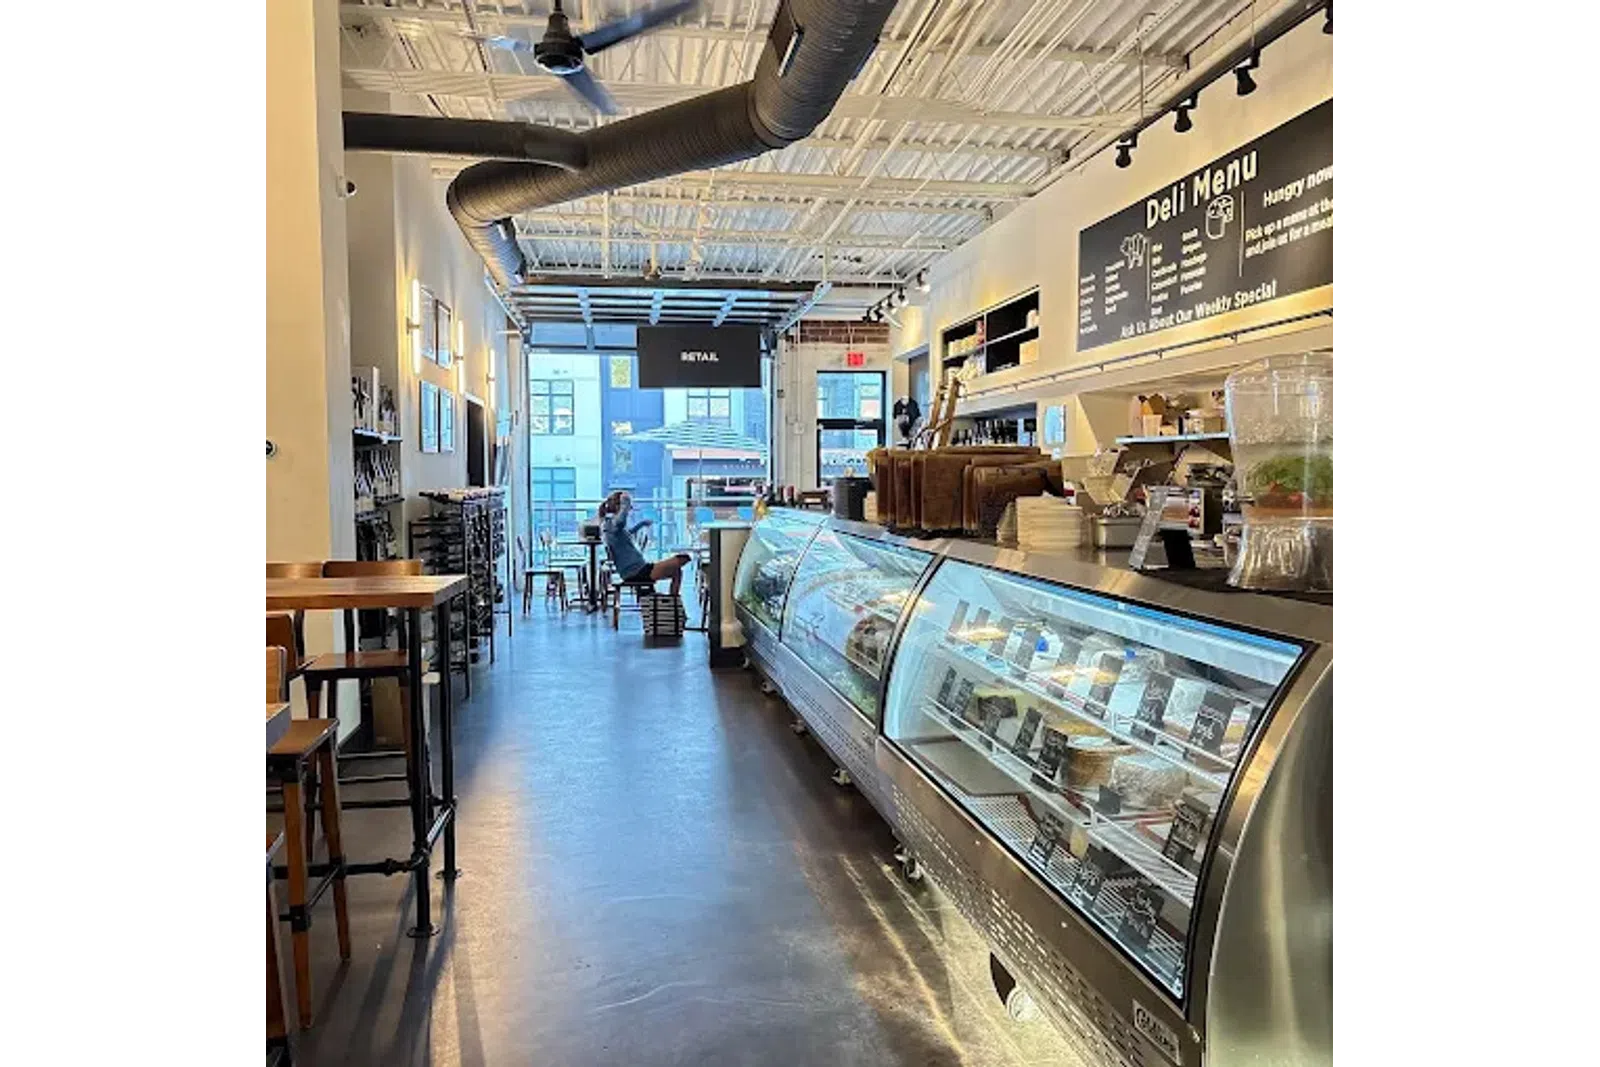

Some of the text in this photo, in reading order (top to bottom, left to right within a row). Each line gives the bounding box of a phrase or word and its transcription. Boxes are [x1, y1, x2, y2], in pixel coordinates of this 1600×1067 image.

[1146, 150, 1257, 229] Deli Menu
[1263, 177, 1305, 208] Hungry
[1245, 225, 1263, 242] Pick
[1120, 278, 1278, 338] Ask Us About Our Weekly Special
[680, 351, 720, 362] RETAIL
